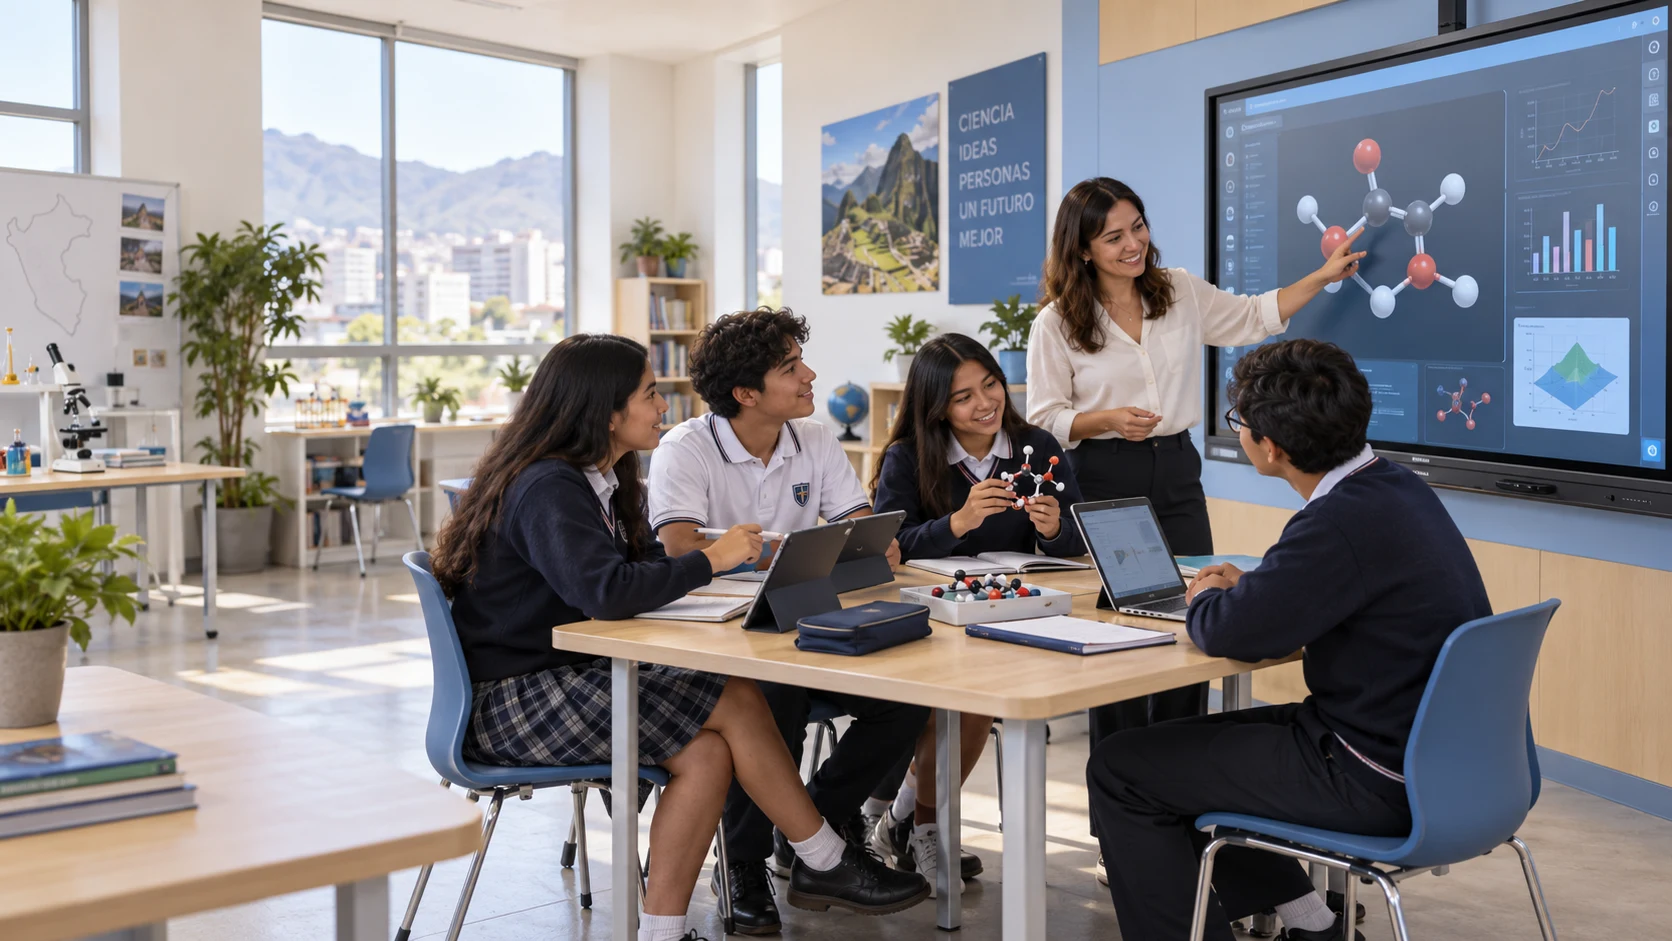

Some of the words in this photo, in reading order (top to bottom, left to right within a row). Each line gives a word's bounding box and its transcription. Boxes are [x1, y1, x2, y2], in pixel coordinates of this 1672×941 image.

[958, 102, 1015, 132] CIENCIA
[959, 137, 997, 162] IDEAS
[959, 162, 1030, 191] PERSONAS
[959, 200, 977, 220] UN
[981, 192, 1034, 217] FUTURO
[959, 226, 1003, 248] MEJOR
